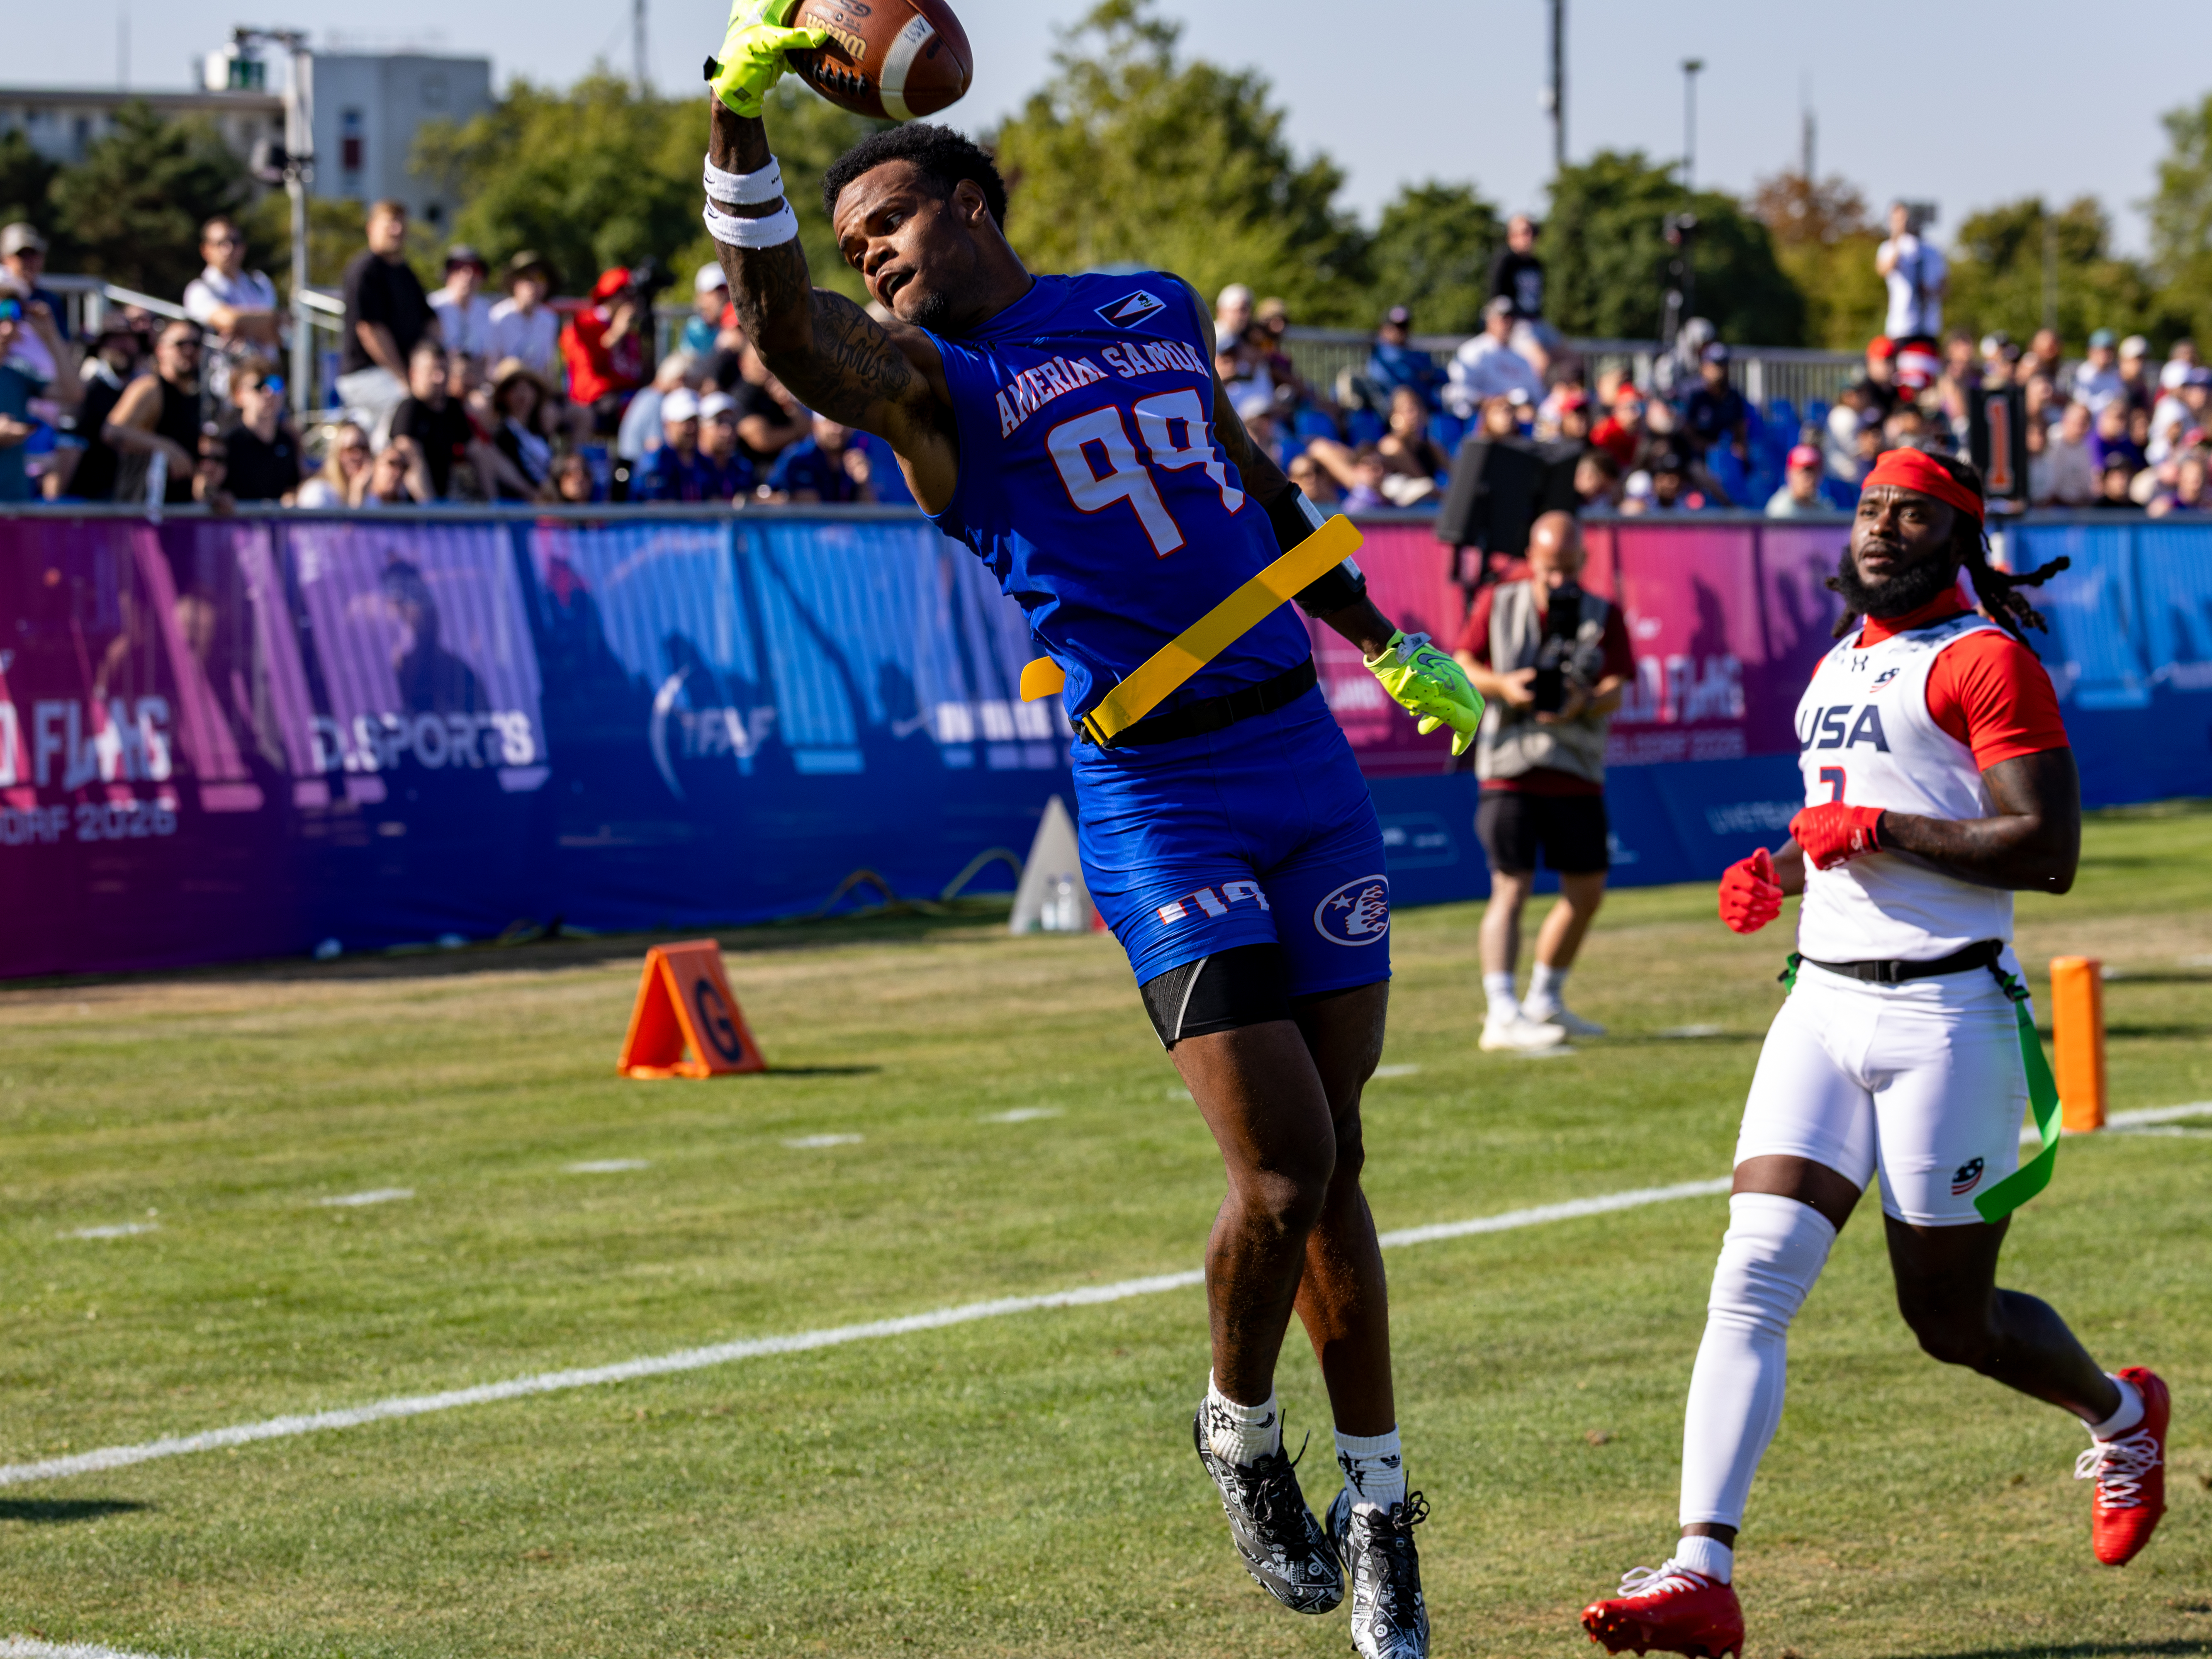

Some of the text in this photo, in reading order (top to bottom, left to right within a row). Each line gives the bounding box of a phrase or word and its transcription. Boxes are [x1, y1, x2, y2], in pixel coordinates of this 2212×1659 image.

[805, 12, 867, 61] Wilson
[1101, 340, 1211, 379] SAMOA
[1044, 386, 1246, 560] 99
[34, 698, 172, 792] FLAG
[1800, 703, 1891, 753] USA
[695, 978, 742, 1063] G
[1379, 1632, 1398, 1647] AD1Z3RO
